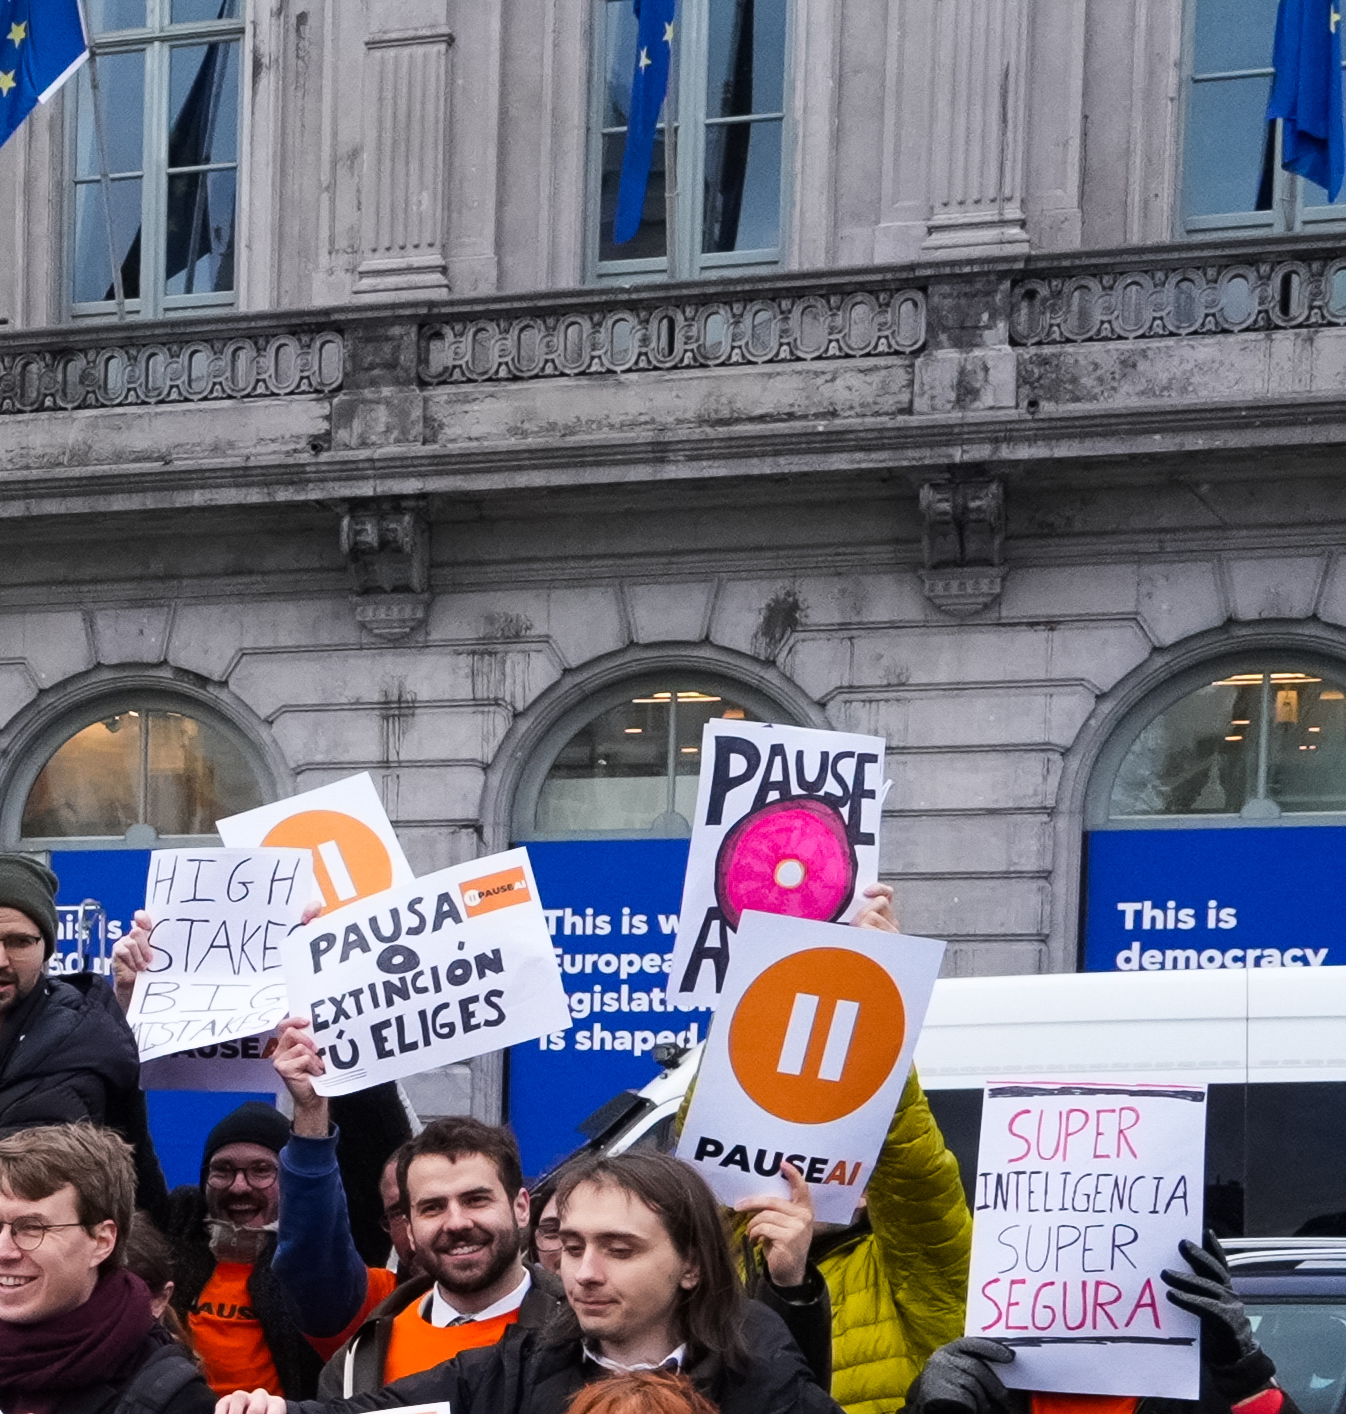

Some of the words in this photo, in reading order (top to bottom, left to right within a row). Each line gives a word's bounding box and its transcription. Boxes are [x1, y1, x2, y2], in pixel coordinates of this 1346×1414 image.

[705, 735, 879, 846] PAUSE
[152, 855, 301, 906] HIGH
[477, 879, 527, 900] PAUSEAI
[309, 891, 464, 975] PAUSA
[542, 907, 612, 935] This
[621, 907, 649, 935] is
[1117, 901, 1196, 931] This
[1207, 900, 1238, 930] is
[376, 943, 421, 975] O
[1117, 943, 1329, 973] democracy
[139, 980, 288, 1015] BIG
[309, 940, 505, 1035] EXTINCIÓN
[369, 988, 507, 1061] ELIGES
[574, 1022, 700, 1057] shaped
[1007, 1106, 1141, 1163] SUPER
[694, 1135, 862, 1187] PAUSEAI
[975, 1170, 1190, 1217] INTELIGENCIA
[997, 1223, 1140, 1274] SUPER
[980, 1277, 1162, 1333] SEGURA
